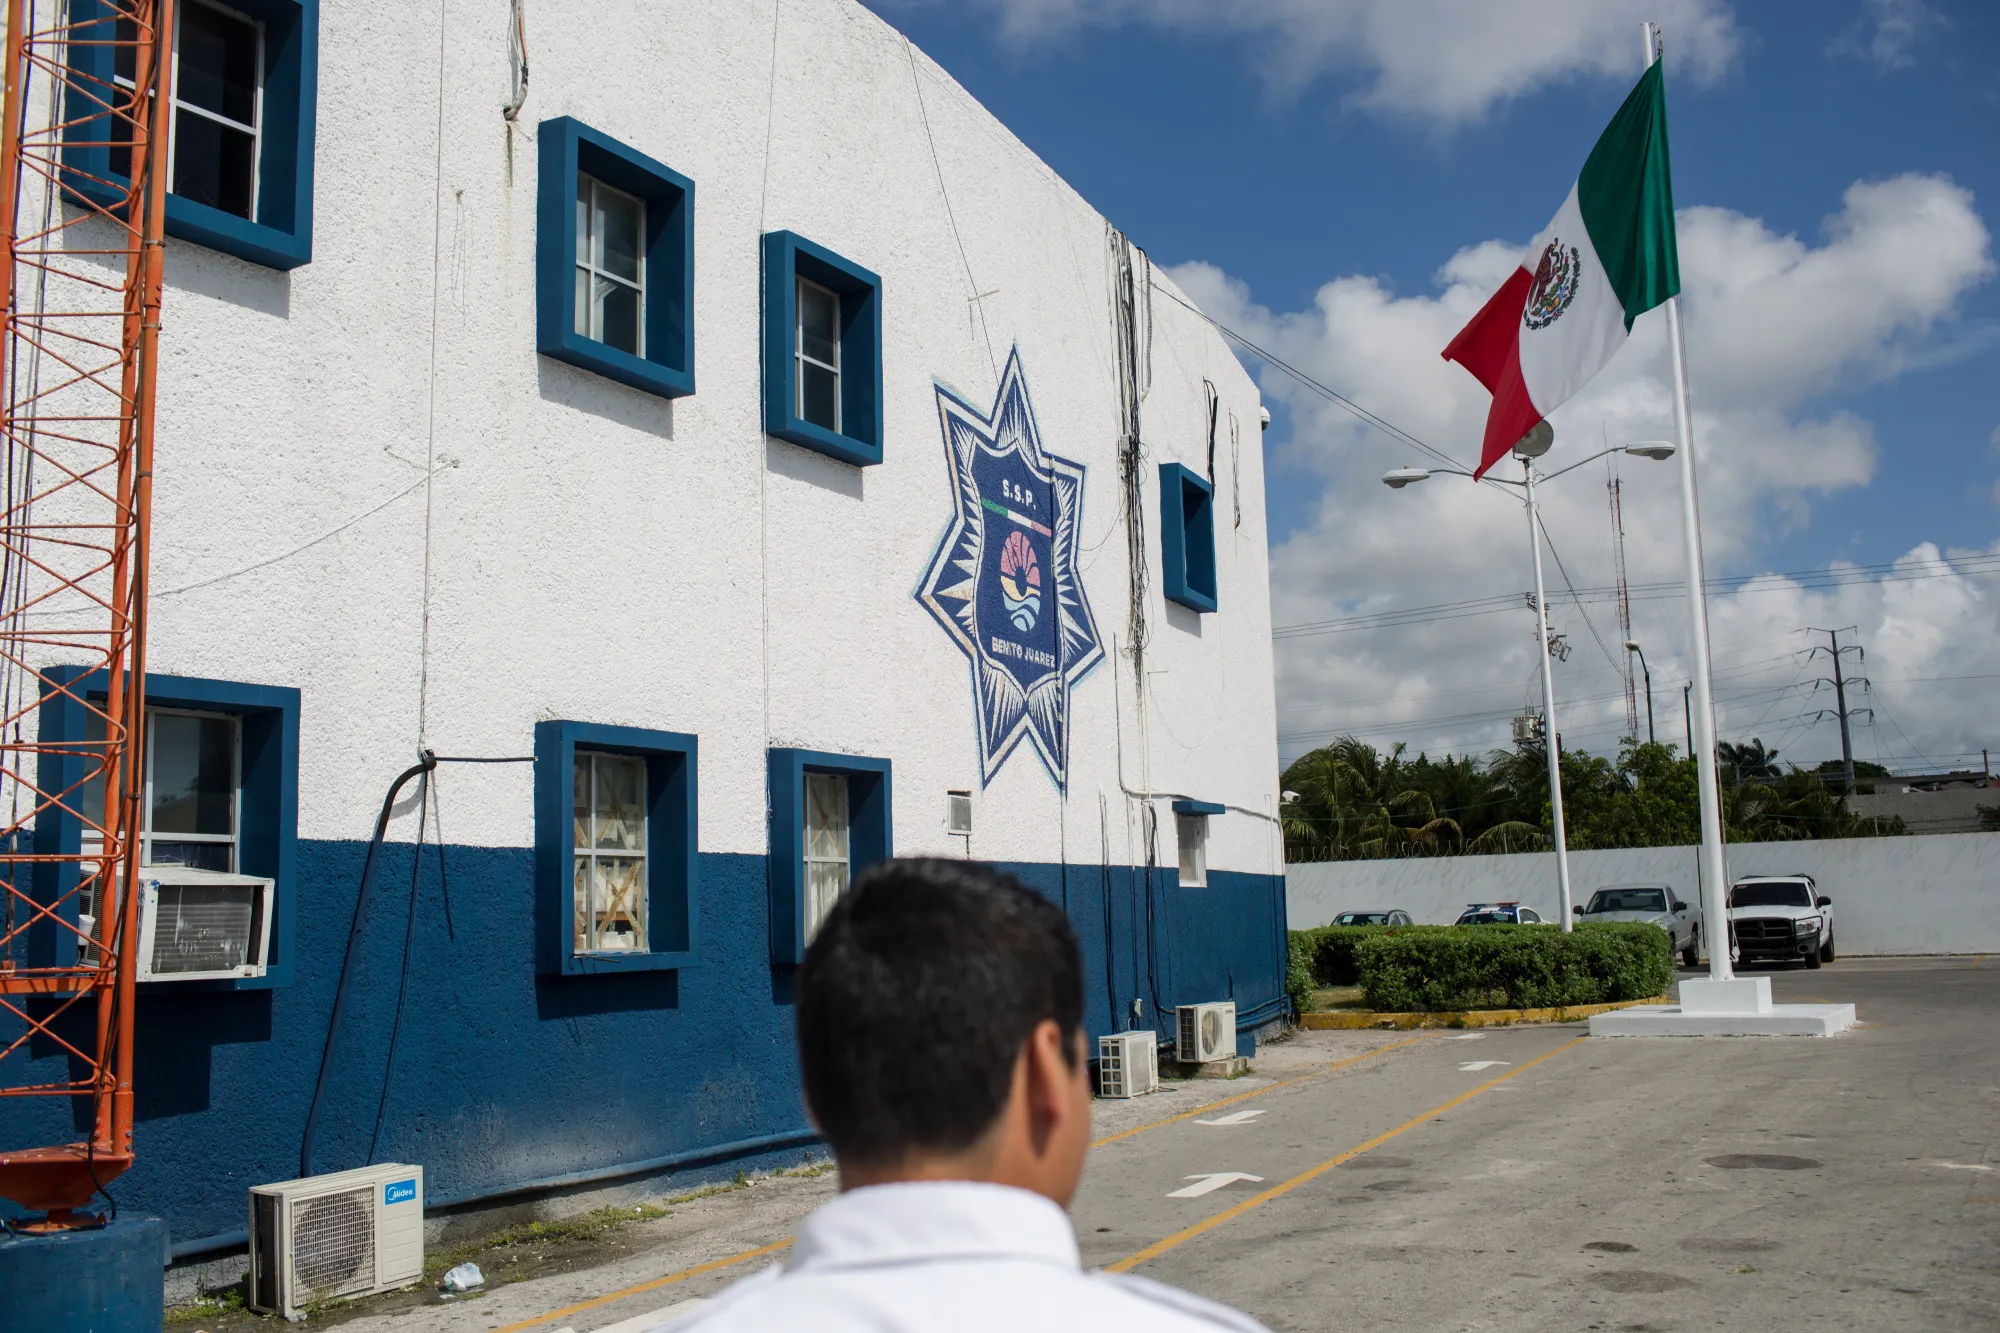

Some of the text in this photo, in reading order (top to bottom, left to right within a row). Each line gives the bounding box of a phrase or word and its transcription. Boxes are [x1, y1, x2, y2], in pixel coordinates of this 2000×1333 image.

[1002, 479, 1036, 510] S.S.P.
[991, 636, 1056, 669] BENITO JUAREZ
[388, 1187, 413, 1200] Midea
